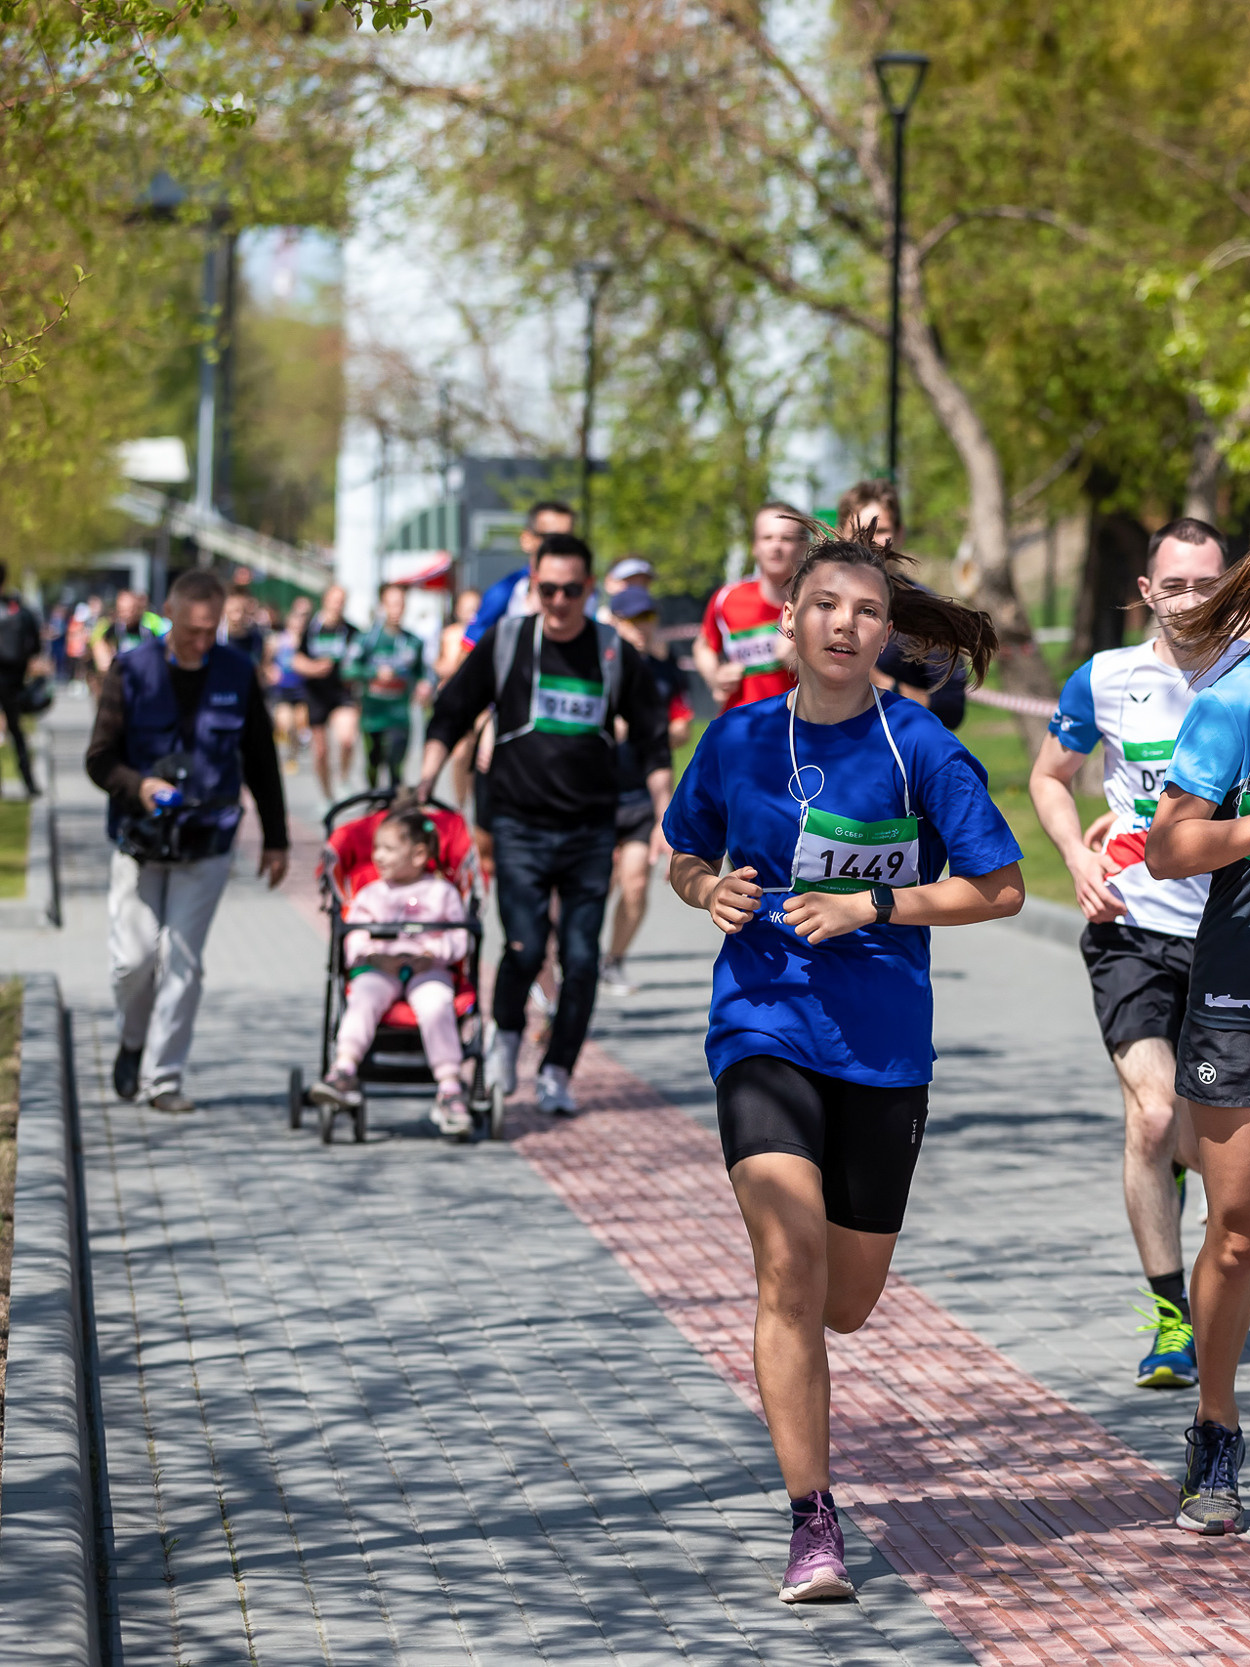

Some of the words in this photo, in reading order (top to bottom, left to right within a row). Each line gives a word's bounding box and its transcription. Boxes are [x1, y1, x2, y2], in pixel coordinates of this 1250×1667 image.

[844, 830, 864, 838] СБЕР
[820, 849, 905, 881] 1449
[769, 910, 787, 924] ЧК
